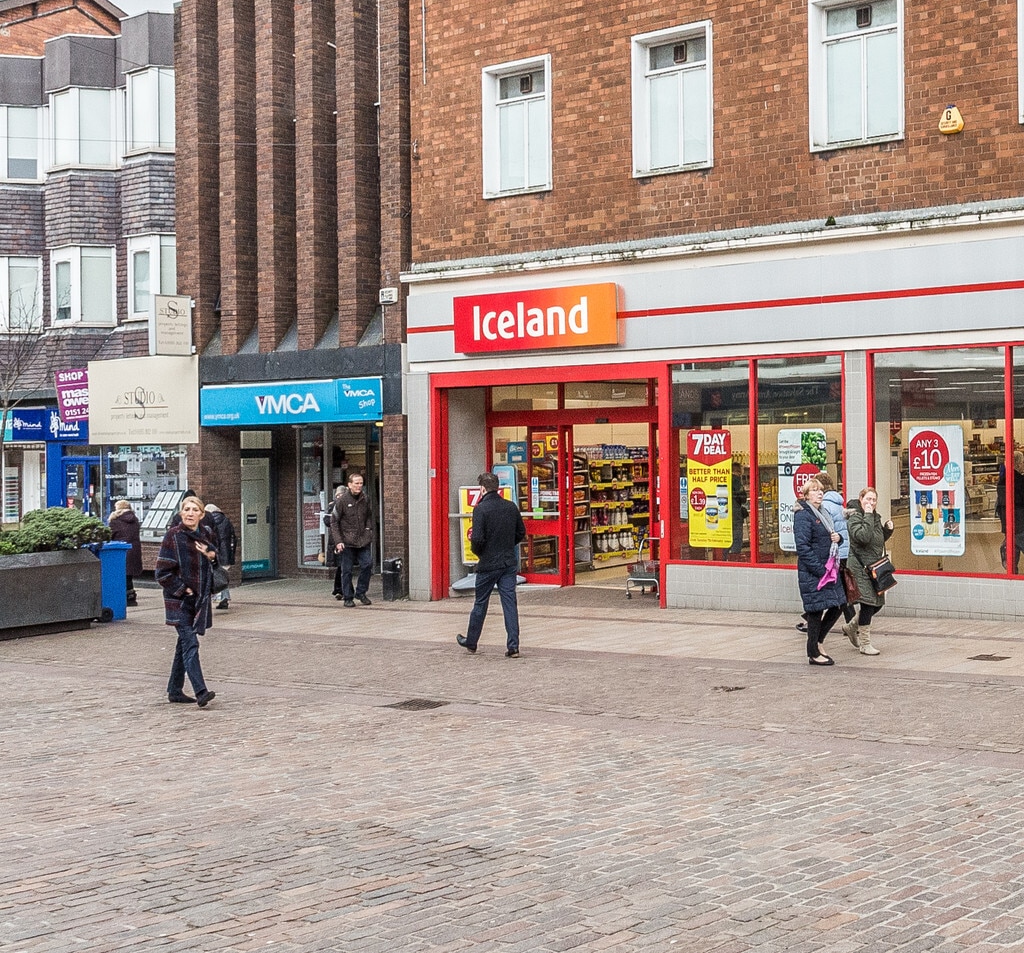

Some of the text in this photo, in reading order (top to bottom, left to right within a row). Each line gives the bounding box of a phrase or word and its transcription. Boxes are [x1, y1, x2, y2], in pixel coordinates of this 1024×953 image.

[473, 296, 589, 341] Iceland
[58, 372, 84, 382] SHOP
[255, 389, 375, 415] YMCA YMCA
[358, 398, 375, 409] Shop
[65, 408, 81, 417] 0151
[692, 433, 726, 455] 7 DAY
[916, 439, 939, 448] ANY 3
[703, 445, 726, 455] DEAL
[913, 449, 942, 469] £10
[780, 503, 793, 511] Sho
